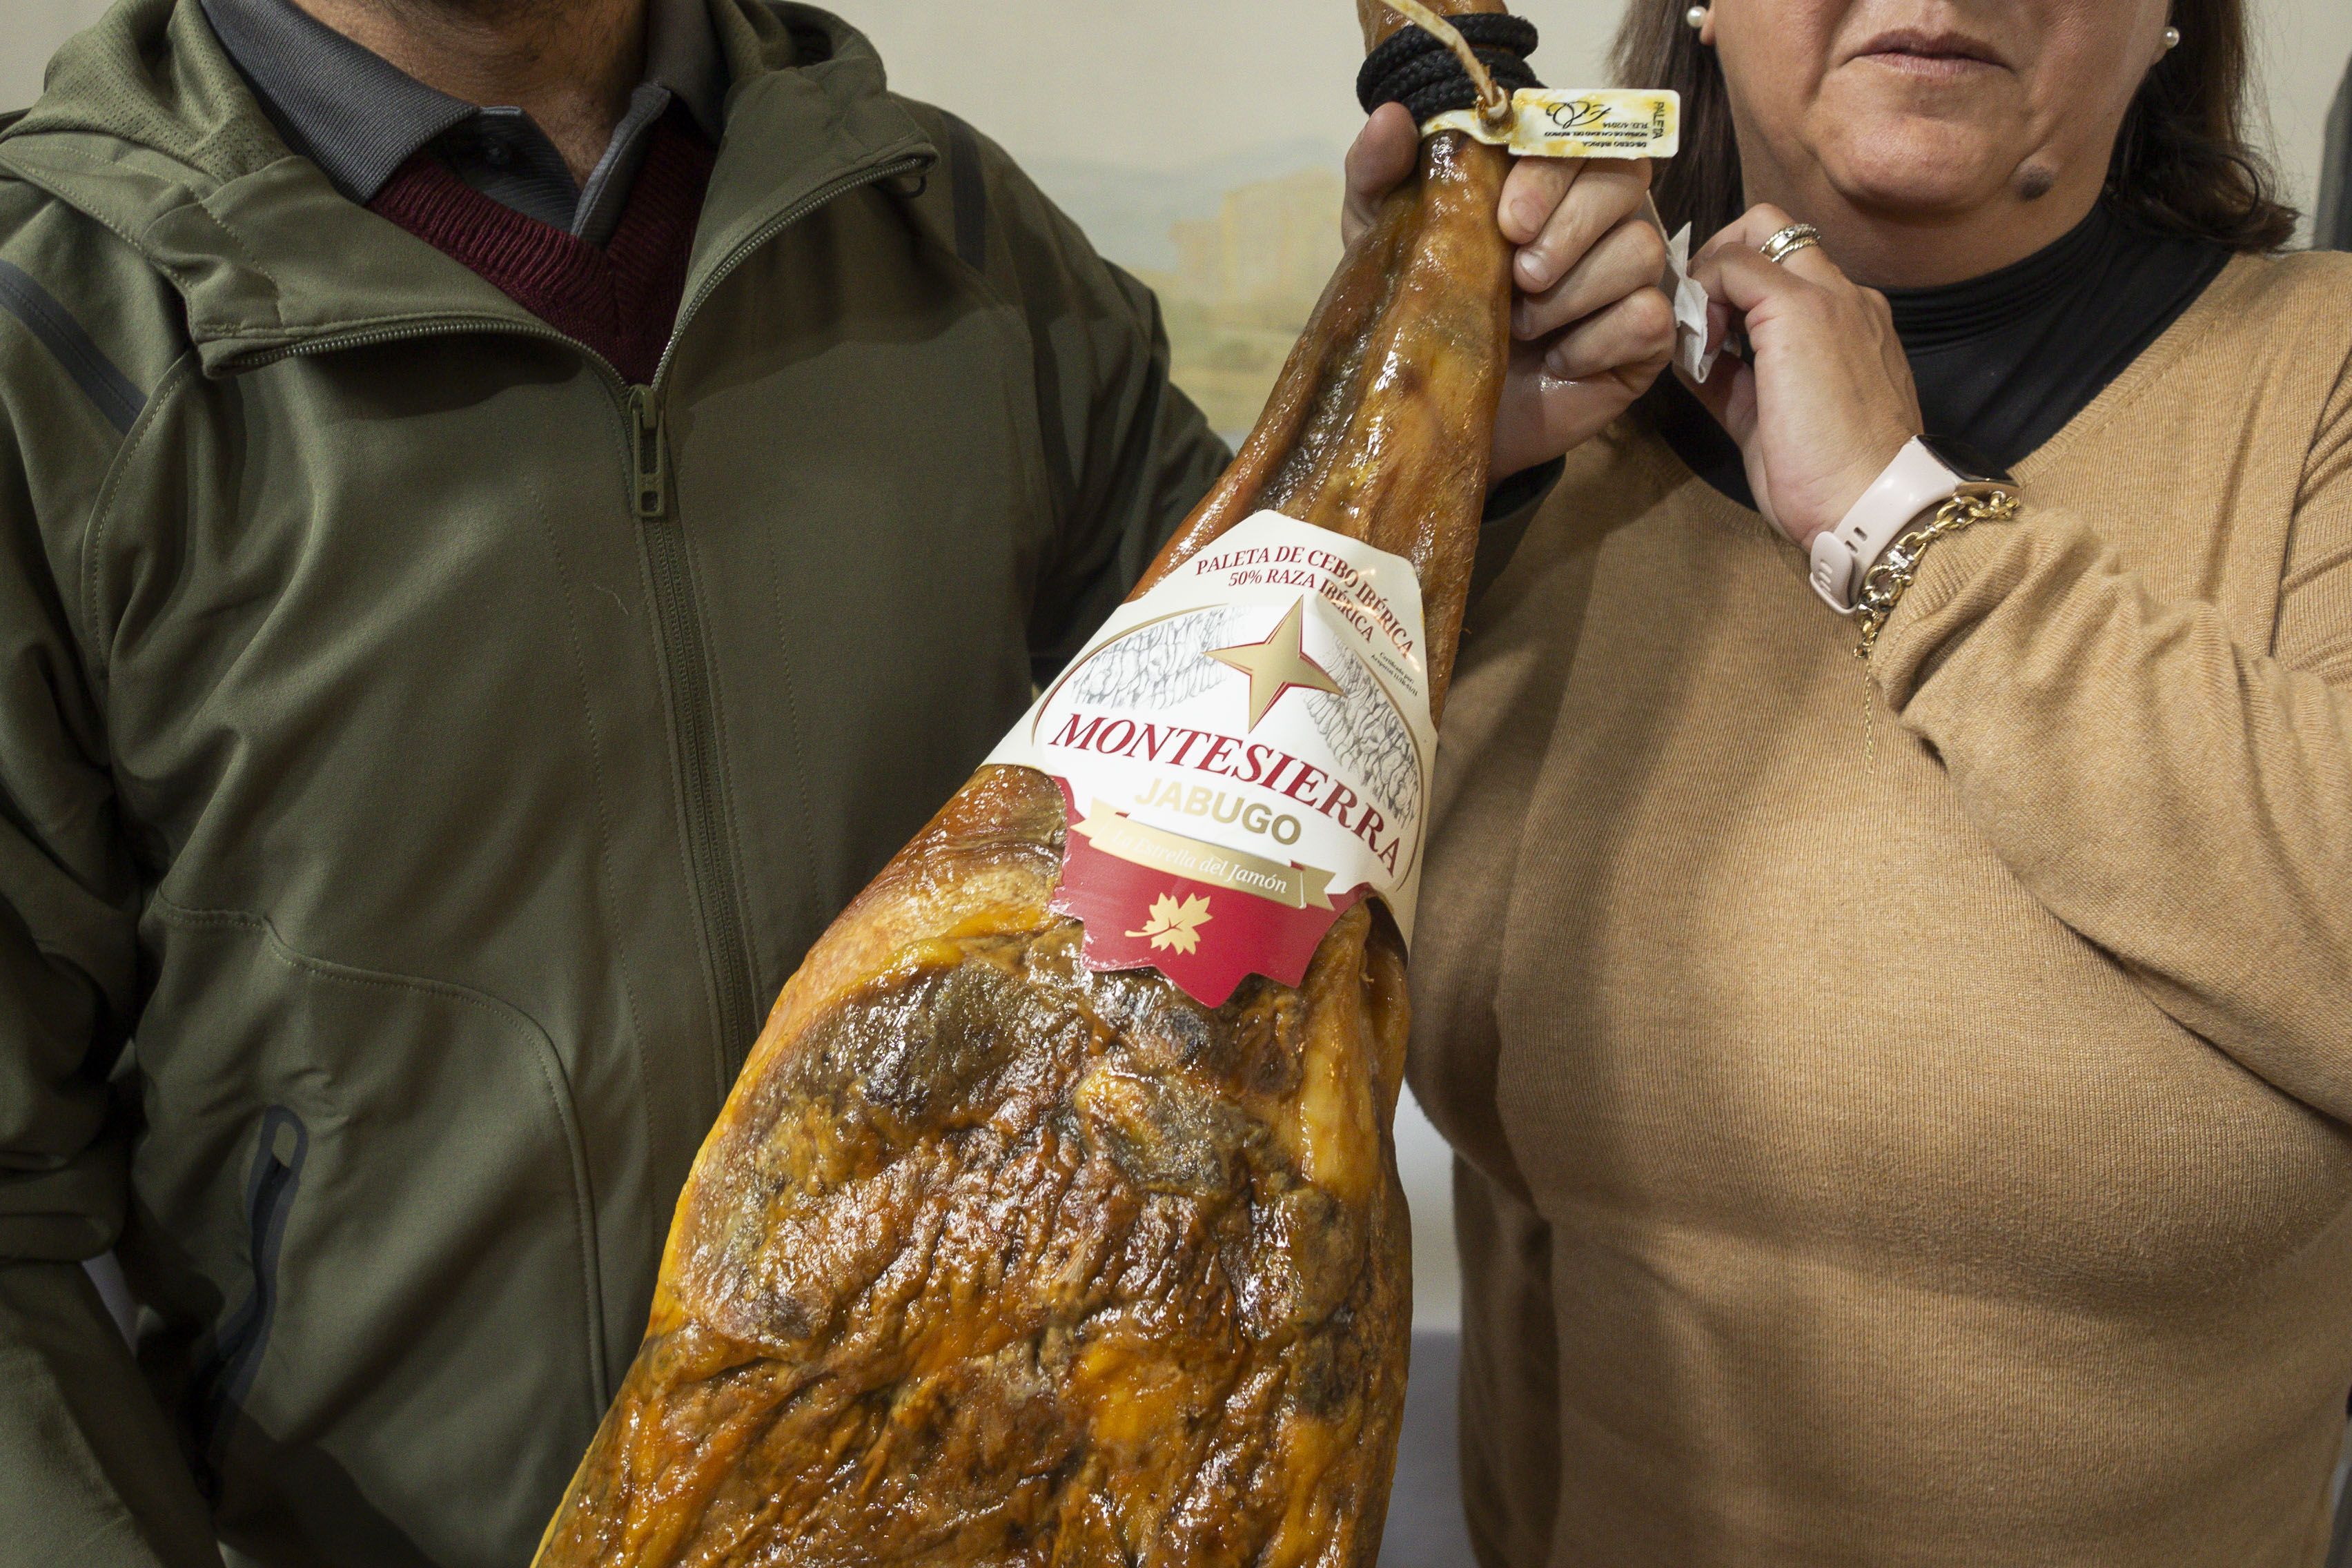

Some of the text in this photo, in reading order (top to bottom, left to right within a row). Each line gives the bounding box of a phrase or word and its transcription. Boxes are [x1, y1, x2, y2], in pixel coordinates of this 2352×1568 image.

[1652, 101, 1665, 139] PALETA
[1195, 546, 1414, 660] PALETA DE CEBO IBÉRICA
[1228, 569, 1376, 643] 50% RAZA IBÉRICA
[1048, 713, 1401, 878] MONTESIERRA
[1135, 778, 1302, 845] JABUGO
[1112, 830, 1288, 894] La Estrella del Jamón
